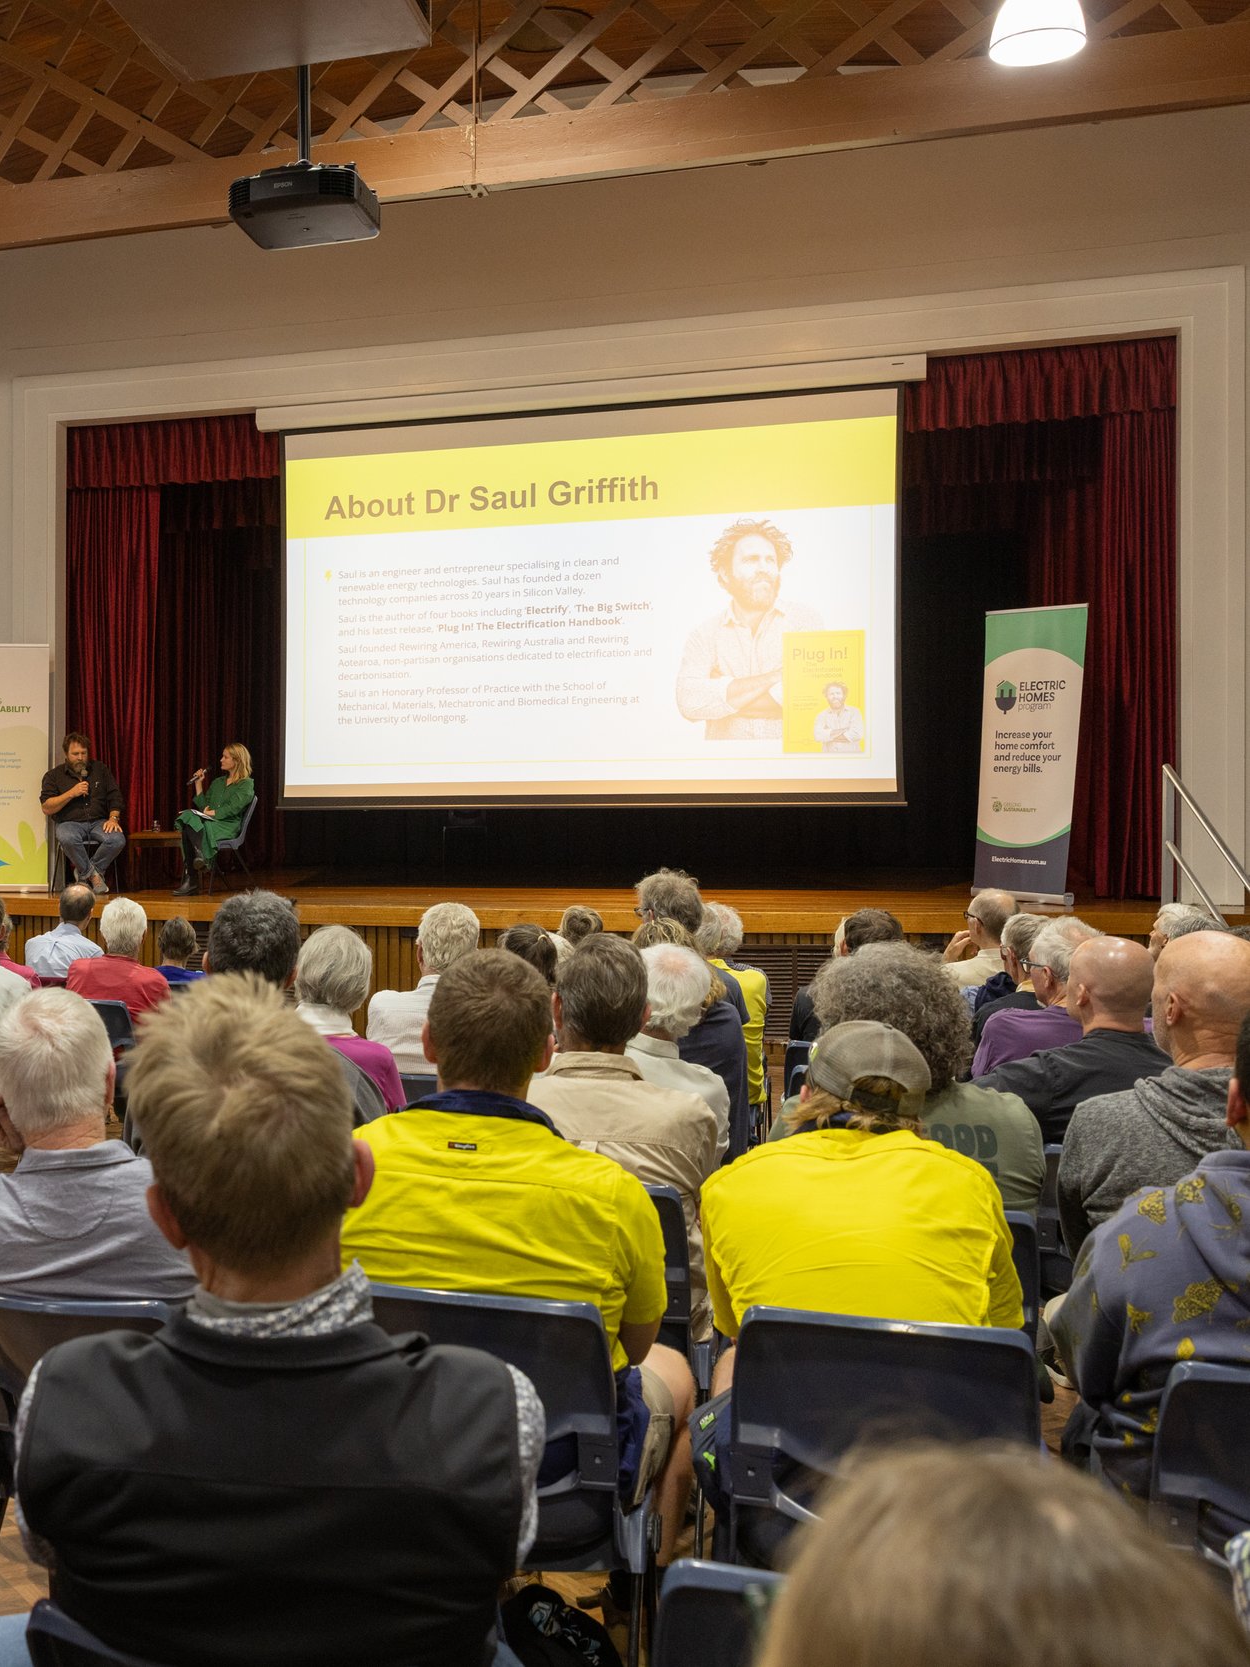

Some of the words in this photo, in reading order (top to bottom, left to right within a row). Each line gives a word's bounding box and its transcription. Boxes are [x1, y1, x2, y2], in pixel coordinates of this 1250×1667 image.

[273, 181, 292, 189] EPSON
[324, 490, 415, 520] About
[425, 488, 460, 514] Dr
[469, 483, 536, 511] Saul
[548, 475, 659, 506] Griffith
[338, 569, 357, 579] Saul
[359, 568, 367, 578] is
[382, 566, 422, 579] engineer
[424, 565, 441, 575] and
[443, 562, 505, 576] entrepreneur
[506, 559, 560, 573] specialising
[562, 558, 571, 568] in
[573, 557, 599, 568] clean
[601, 556, 619, 566] and
[338, 581, 385, 592] renewable
[387, 581, 418, 592] energy
[420, 576, 479, 591] technologies.
[482, 575, 501, 585] Saul
[503, 574, 520, 584] has
[522, 572, 562, 583] founded
[572, 570, 602, 581] dozen
[338, 594, 387, 609] technology
[389, 592, 438, 606] companies
[440, 593, 469, 601] across
[471, 590, 483, 600] 20
[484, 591, 510, 602] years
[512, 588, 521, 598] in
[523, 587, 553, 597] Silicon
[555, 585, 586, 598] Valley.
[338, 613, 357, 623] Saul
[359, 613, 366, 622] is
[368, 612, 383, 622] the
[385, 611, 415, 621] author
[418, 610, 427, 620] of
[429, 609, 448, 619] four
[450, 608, 478, 618] books
[480, 606, 523, 620] including
[597, 602, 613, 615] Big
[338, 627, 355, 637] and
[357, 626, 370, 636] his
[372, 625, 397, 636] latest
[399, 624, 434, 637] release,
[461, 622, 474, 632] In!
[476, 621, 495, 631] The
[496, 618, 566, 630] Electrification
[338, 644, 357, 654] Saul
[359, 643, 397, 653] founded
[398, 641, 438, 654] Rewiring
[439, 640, 479, 653] America,
[482, 638, 522, 651] Rewiring
[523, 637, 565, 647] Australia
[567, 636, 585, 646] and
[588, 634, 629, 648] Rewiring
[338, 657, 381, 670] Aotearoa,
[383, 655, 441, 669] non-partisan
[442, 652, 505, 666] organisations
[506, 650, 553, 661] dedicated
[554, 650, 565, 660] to
[566, 648, 631, 659] electrification
[633, 647, 652, 657] and
[792, 648, 825, 663] Plug
[830, 647, 847, 659] In!
[338, 668, 411, 680] decarbonisation.
[338, 688, 357, 697] Saul
[359, 687, 366, 697] is
[382, 686, 424, 699] Honorary
[426, 684, 470, 695] Professor
[472, 684, 482, 693] of
[483, 683, 520, 693] Practice
[522, 682, 542, 692] with
[544, 682, 561, 691] the
[562, 680, 594, 691] School
[596, 680, 607, 690] of
[1019, 680, 1066, 691] ELECTRIC
[338, 700, 390, 714] Mechanical,
[392, 699, 436, 712] Materials,
[438, 698, 495, 708] Mechatronic
[497, 697, 516, 707] and
[517, 696, 569, 706] Biomedical
[571, 694, 628, 707] Engineering
[630, 694, 640, 703] at
[1018, 692, 1055, 702] HOMES
[1018, 702, 1052, 712] program
[337, 715, 353, 725] the
[354, 714, 399, 727] University
[400, 714, 410, 723] of
[412, 712, 469, 725] Wollongong.
[995, 730, 1030, 739] Increase
[1032, 732, 1052, 740] your
[994, 741, 1018, 750] home
[1020, 741, 1055, 750] comfort
[994, 752, 1011, 761] and
[1012, 752, 1041, 761] reduce
[1042, 754, 1062, 763] your
[993, 765, 1022, 775] energy
[1023, 764, 1043, 773] bills.
[991, 856, 1047, 865] ElectricHomes.com.au
[922, 1122, 998, 1160] OOD
